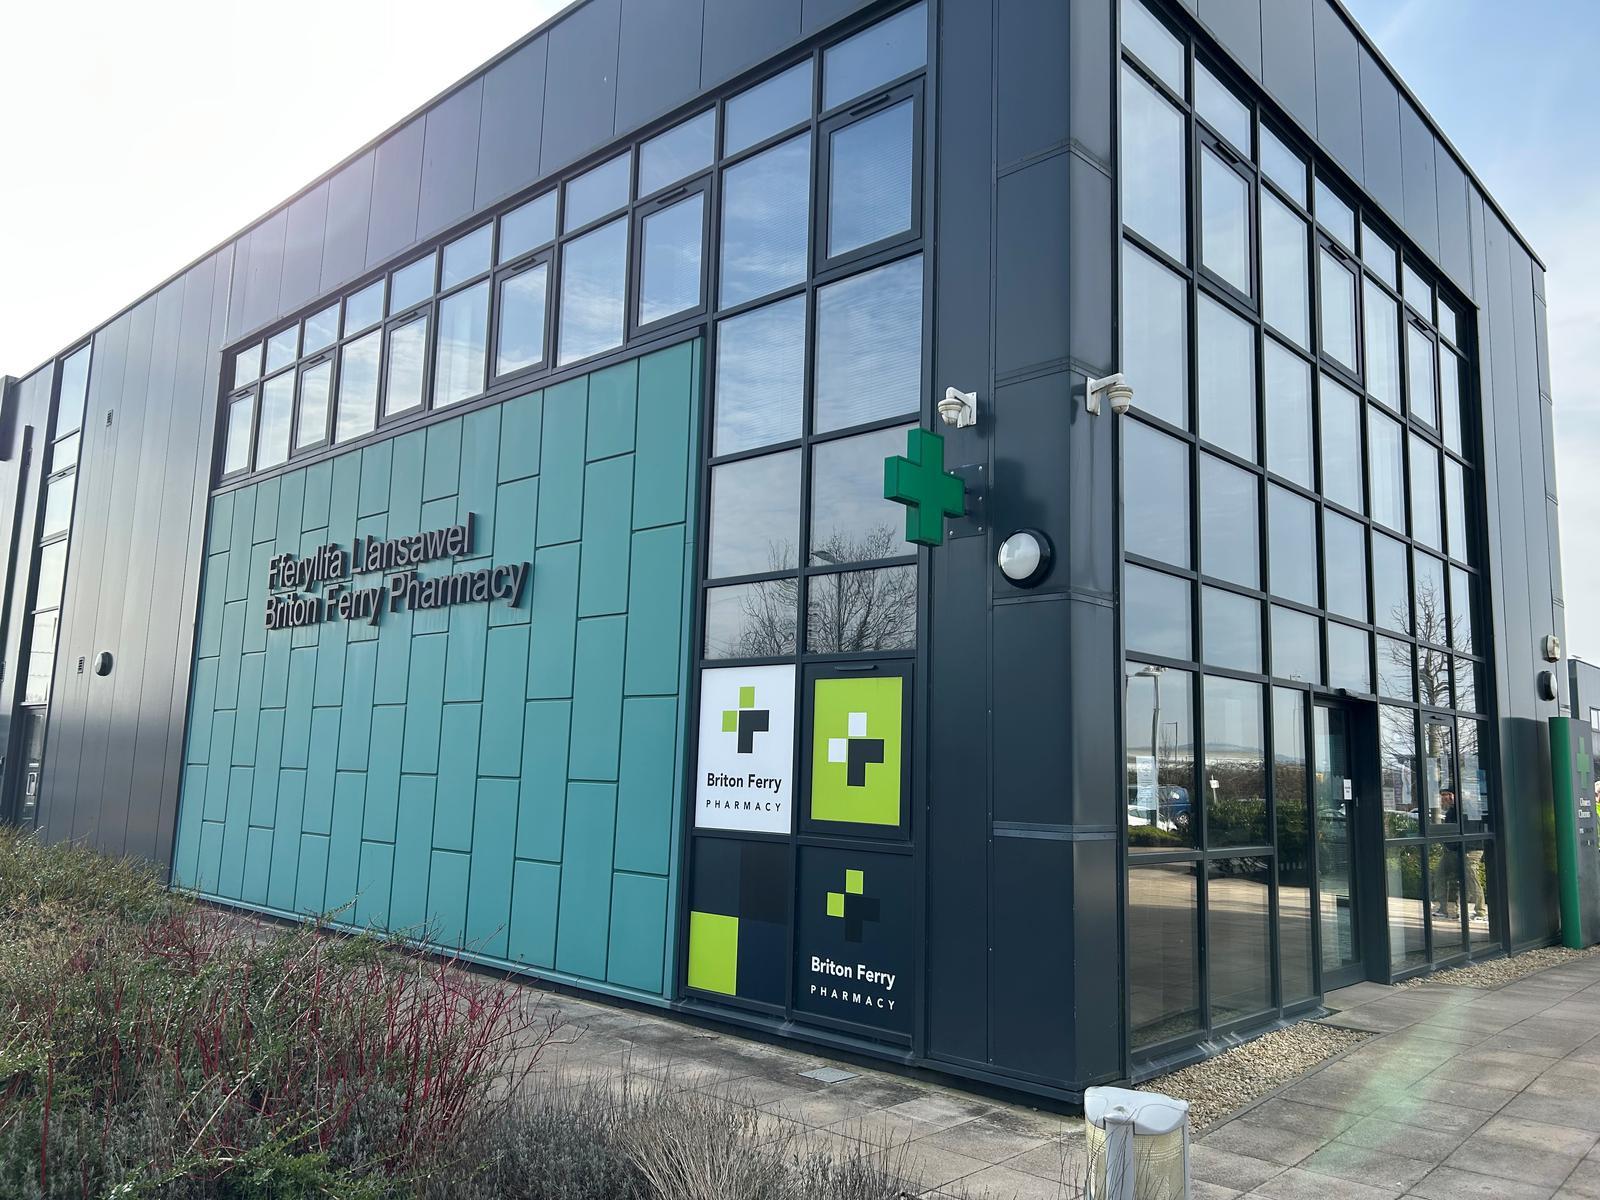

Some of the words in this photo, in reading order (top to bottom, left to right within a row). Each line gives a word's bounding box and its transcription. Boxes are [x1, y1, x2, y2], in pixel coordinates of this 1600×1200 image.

[268, 543, 344, 592] Fferyllfa
[351, 512, 475, 574] Llansawel
[264, 591, 321, 630] Briton
[324, 584, 386, 626] Ferry
[388, 562, 530, 612] Pharmacy
[707, 772, 744, 788] Briton
[748, 774, 782, 793] Ferry
[706, 799, 781, 812] PHARMACY
[811, 956, 853, 978] Briton
[856, 964, 896, 990] Ferry
[810, 985, 895, 1010] PHARMACY
